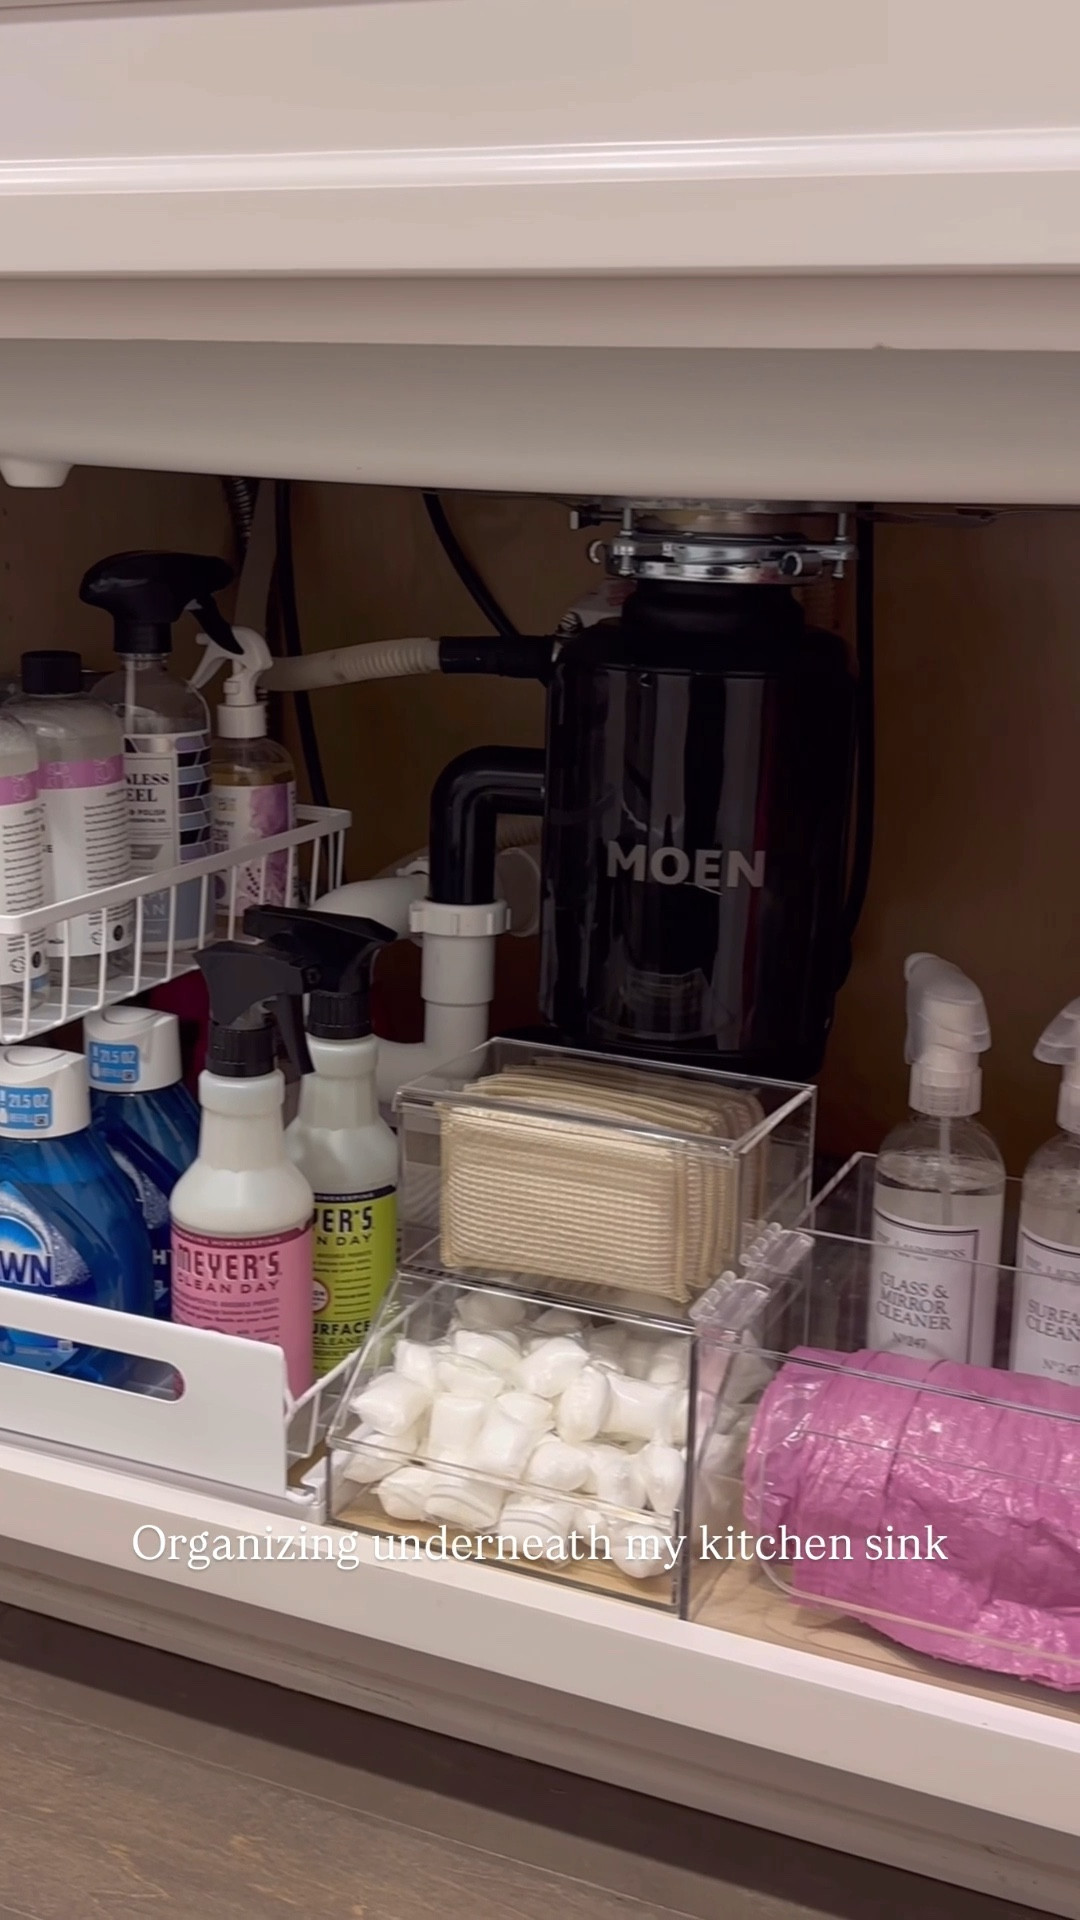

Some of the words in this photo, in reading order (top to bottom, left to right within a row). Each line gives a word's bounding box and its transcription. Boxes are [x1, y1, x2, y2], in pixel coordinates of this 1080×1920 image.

[606, 841, 767, 888] MOEN
[336, 1233, 371, 1247] DAY
[240, 1280, 280, 1295] DAY
[879, 1270, 930, 1298] GLASS
[932, 1284, 950, 1299] &
[876, 1300, 953, 1331] CLEANER
[880, 1286, 949, 1316] MIRROR
